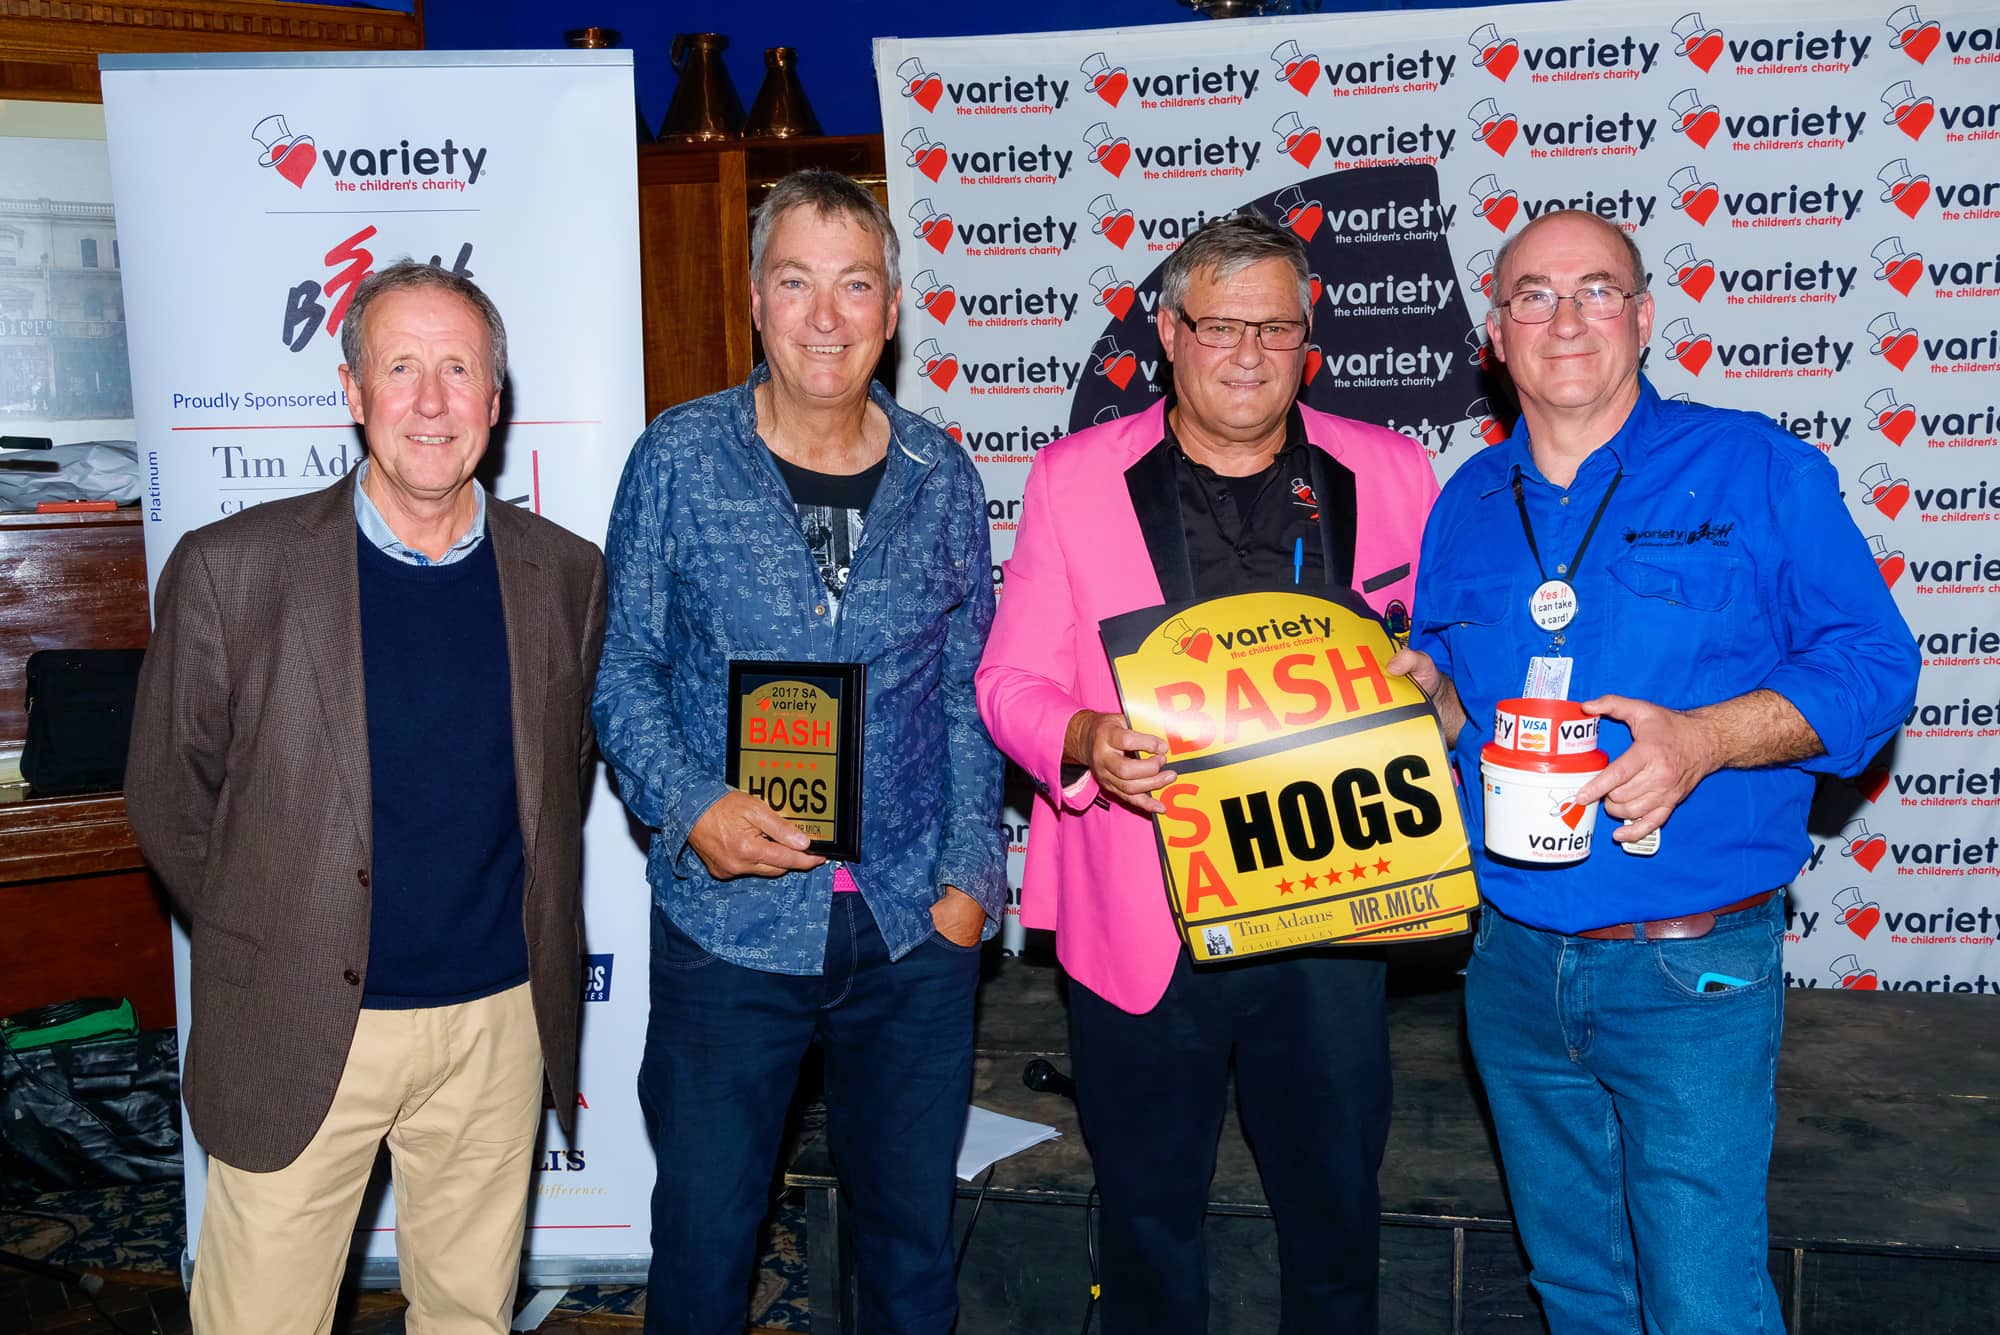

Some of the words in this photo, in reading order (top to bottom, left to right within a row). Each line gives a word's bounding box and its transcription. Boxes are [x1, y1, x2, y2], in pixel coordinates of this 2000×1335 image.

[1524, 36, 1659, 73] variety
[1729, 30, 1871, 66] variety
[1953, 55, 1971, 65] the
[1325, 50, 1456, 85] variety
[1736, 66, 1754, 75] the
[1757, 64, 1808, 74] children's
[1812, 63, 1849, 72] charity
[1133, 64, 1259, 99] variety
[1531, 73, 1549, 82] the
[1552, 72, 1600, 81] children's
[1603, 69, 1639, 79] charity
[947, 74, 1069, 108] variety
[1333, 88, 1350, 96] the
[1352, 85, 1400, 96] children's
[1403, 81, 1438, 92] charity
[956, 106, 974, 115] the
[977, 105, 1018, 115] children's
[1020, 104, 1054, 115] charity
[1141, 100, 1158, 109] the
[1160, 98, 1205, 107] children's
[1208, 96, 1242, 104] charity
[1725, 105, 1866, 142] variety
[1523, 113, 1656, 149] variety
[1946, 132, 1964, 142] the
[1326, 124, 1455, 159] variety
[1732, 141, 1750, 150] the
[1754, 140, 1804, 151] children's
[1808, 139, 1845, 149] charity
[1135, 136, 1260, 170] variety
[1530, 148, 1548, 158] the
[1549, 147, 1598, 157] children's
[1601, 145, 1637, 155] charity
[323, 140, 486, 184] variety
[952, 144, 1072, 178] variety
[960, 176, 977, 185] the
[978, 176, 1022, 184] children's
[1024, 175, 1056, 184] charity
[1143, 170, 1160, 179] the
[1163, 168, 1207, 179] children's
[1210, 167, 1244, 177] charity
[335, 181, 356, 192] the
[360, 180, 417, 192] children's
[423, 179, 466, 193] charity
[1724, 183, 1863, 220] variety
[1327, 199, 1456, 234] variety
[1731, 219, 1749, 228] the
[1752, 218, 1802, 227] children's
[1805, 216, 1842, 226] charity
[1942, 211, 1960, 220] the
[958, 216, 1076, 250] variety
[1336, 234, 1352, 243] the
[1355, 232, 1400, 242] children's
[1404, 231, 1438, 241] charity
[966, 247, 982, 256] the
[983, 248, 1027, 256] children's
[1030, 246, 1062, 256] charity
[1720, 261, 1857, 297] variety
[1327, 273, 1454, 309] variety
[1935, 289, 1953, 298] the
[960, 287, 1078, 321] variety
[1728, 296, 1745, 304] the
[1747, 295, 1796, 304] children's
[1800, 293, 1836, 304] charity
[1334, 308, 1350, 316] the
[1353, 306, 1399, 316] children's
[1402, 304, 1437, 315] charity
[967, 319, 983, 327] the
[985, 318, 1028, 327] children's
[1031, 317, 1063, 327] charity
[1717, 335, 1853, 371] variety
[1327, 345, 1453, 380] variety
[1931, 364, 1948, 373] the
[962, 355, 1080, 391] variety
[1724, 370, 1742, 378] the
[1744, 368, 1793, 378] children's
[1796, 368, 1833, 377] charity
[1335, 379, 1350, 387] the
[1353, 378, 1398, 387] children's
[1402, 376, 1435, 387] charity
[970, 386, 985, 395] the
[987, 386, 1030, 395] children's
[1032, 385, 1065, 395] charity
[173, 392, 240, 411] Proudly
[244, 391, 337, 411] Sponsored
[1928, 439, 1945, 448] the
[1948, 437, 1998, 447] children's
[212, 445, 287, 479] Tim
[975, 454, 989, 463] the
[148, 451, 162, 522] Platinum
[1921, 513, 1938, 522] the
[1941, 512, 1990, 522] children's
[1910, 553, 2000, 583] varie
[1540, 589, 1558, 600] Yes
[1916, 585, 1935, 594] the
[1939, 584, 1985, 594] children's
[1538, 604, 1553, 612] can
[1554, 600, 1572, 610] take
[1216, 613, 1332, 651] variety
[1230, 648, 1247, 660] the
[1248, 640, 1292, 656] children's
[1292, 634, 1325, 649] charity
[1933, 656, 1980, 667] children's
[772, 687, 799, 699] 2017
[801, 688, 817, 699] SA
[772, 699, 817, 714] variety
[1154, 644, 1394, 757] BASH
[749, 717, 831, 748] BASH
[1522, 719, 1548, 732] VISA
[1906, 728, 1923, 738] the
[1925, 727, 1974, 738] children's
[1894, 767, 2000, 796] variet
[749, 776, 828, 815] HOGS
[1901, 797, 1917, 806] the
[1920, 796, 1967, 806] children's
[1220, 754, 1443, 874] HOGS
[1891, 837, 1998, 865] variet
[1897, 866, 1914, 875] the
[1916, 866, 1964, 876] children's
[1234, 919, 1271, 938] Tim
[1275, 911, 1334, 931] Adams
[1891, 935, 1908, 944] the
[1910, 935, 1957, 945] children's
[1959, 935, 1995, 945] charity
